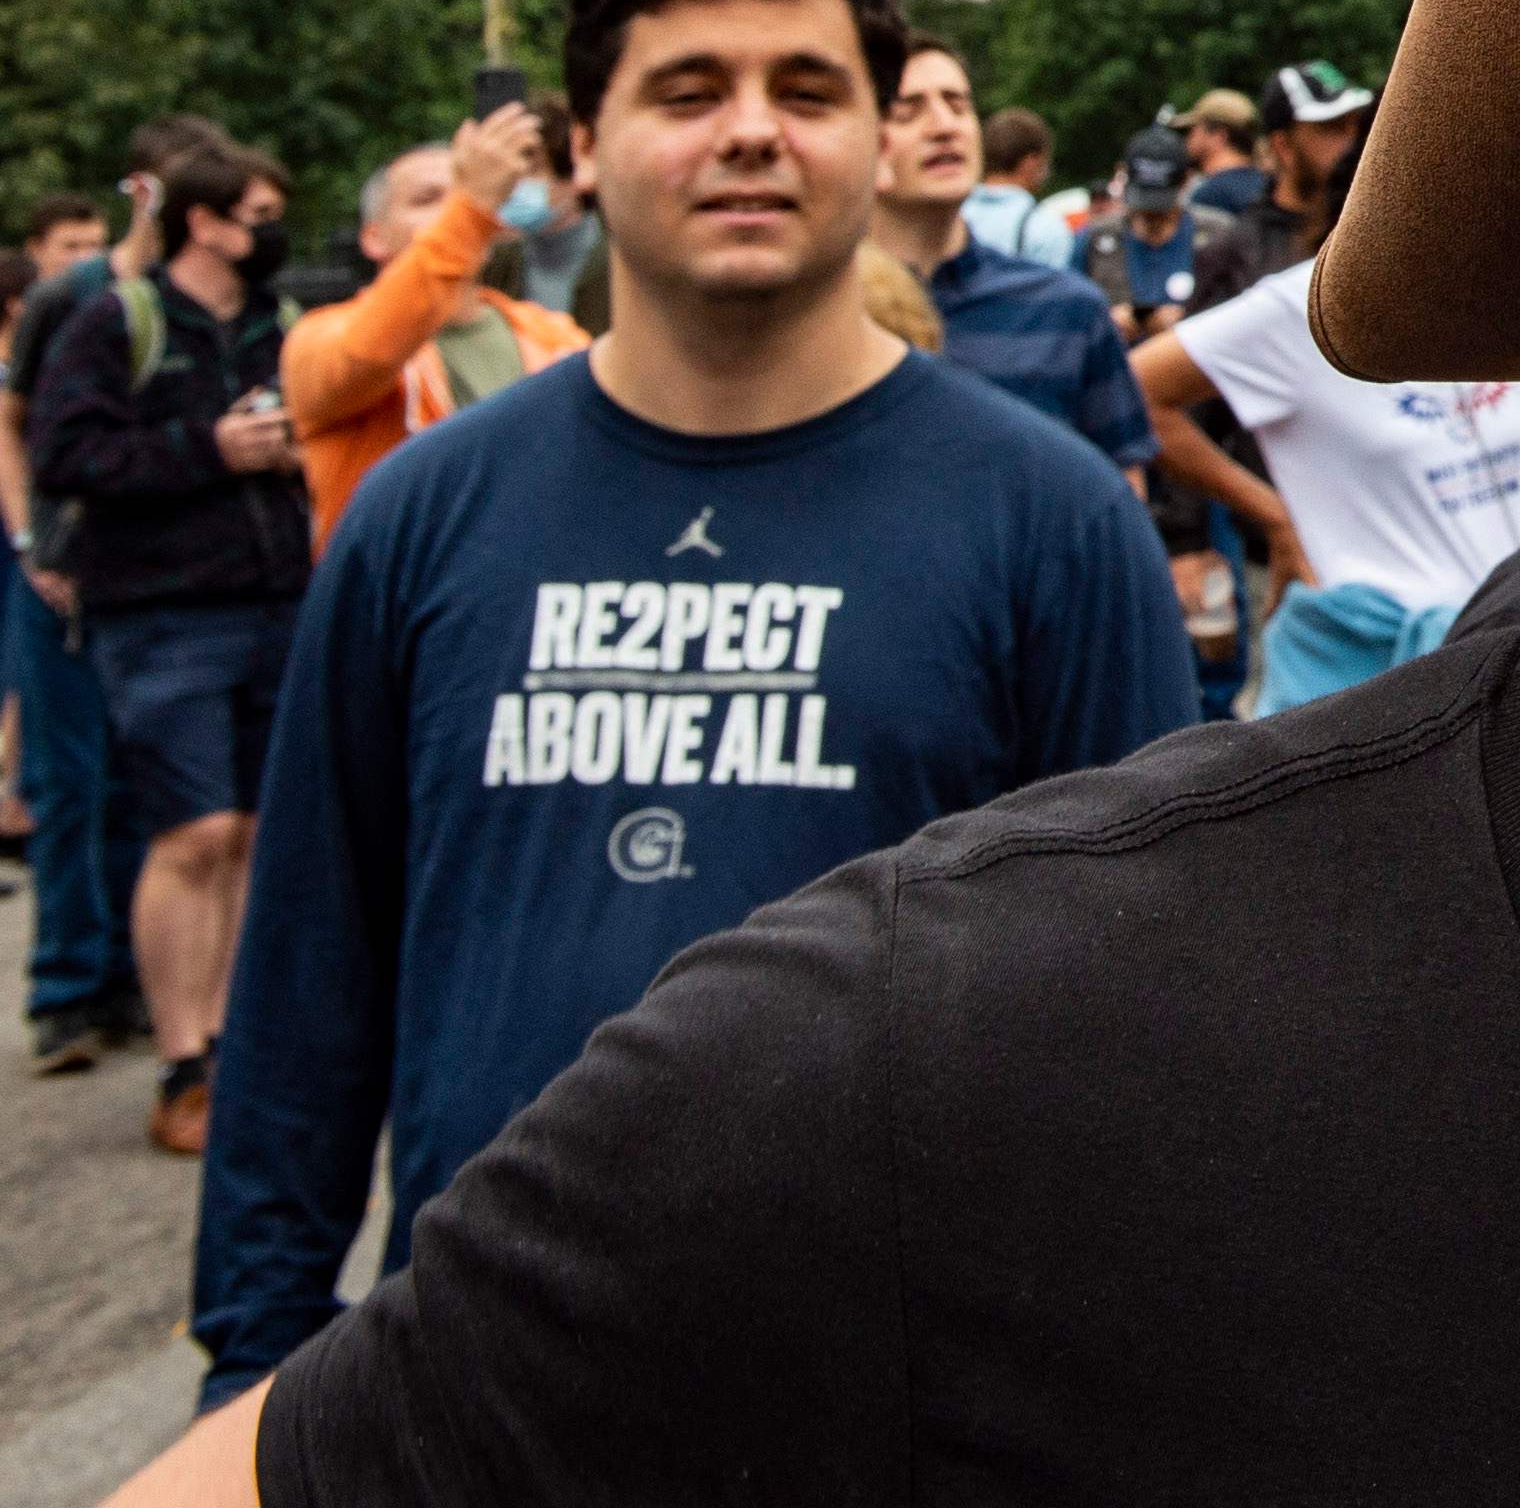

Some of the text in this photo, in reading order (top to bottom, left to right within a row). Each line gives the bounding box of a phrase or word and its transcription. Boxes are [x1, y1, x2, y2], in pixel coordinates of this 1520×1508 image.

[529, 580, 844, 672] RE2PECT
[482, 691, 857, 790] ABOVE ALL.
